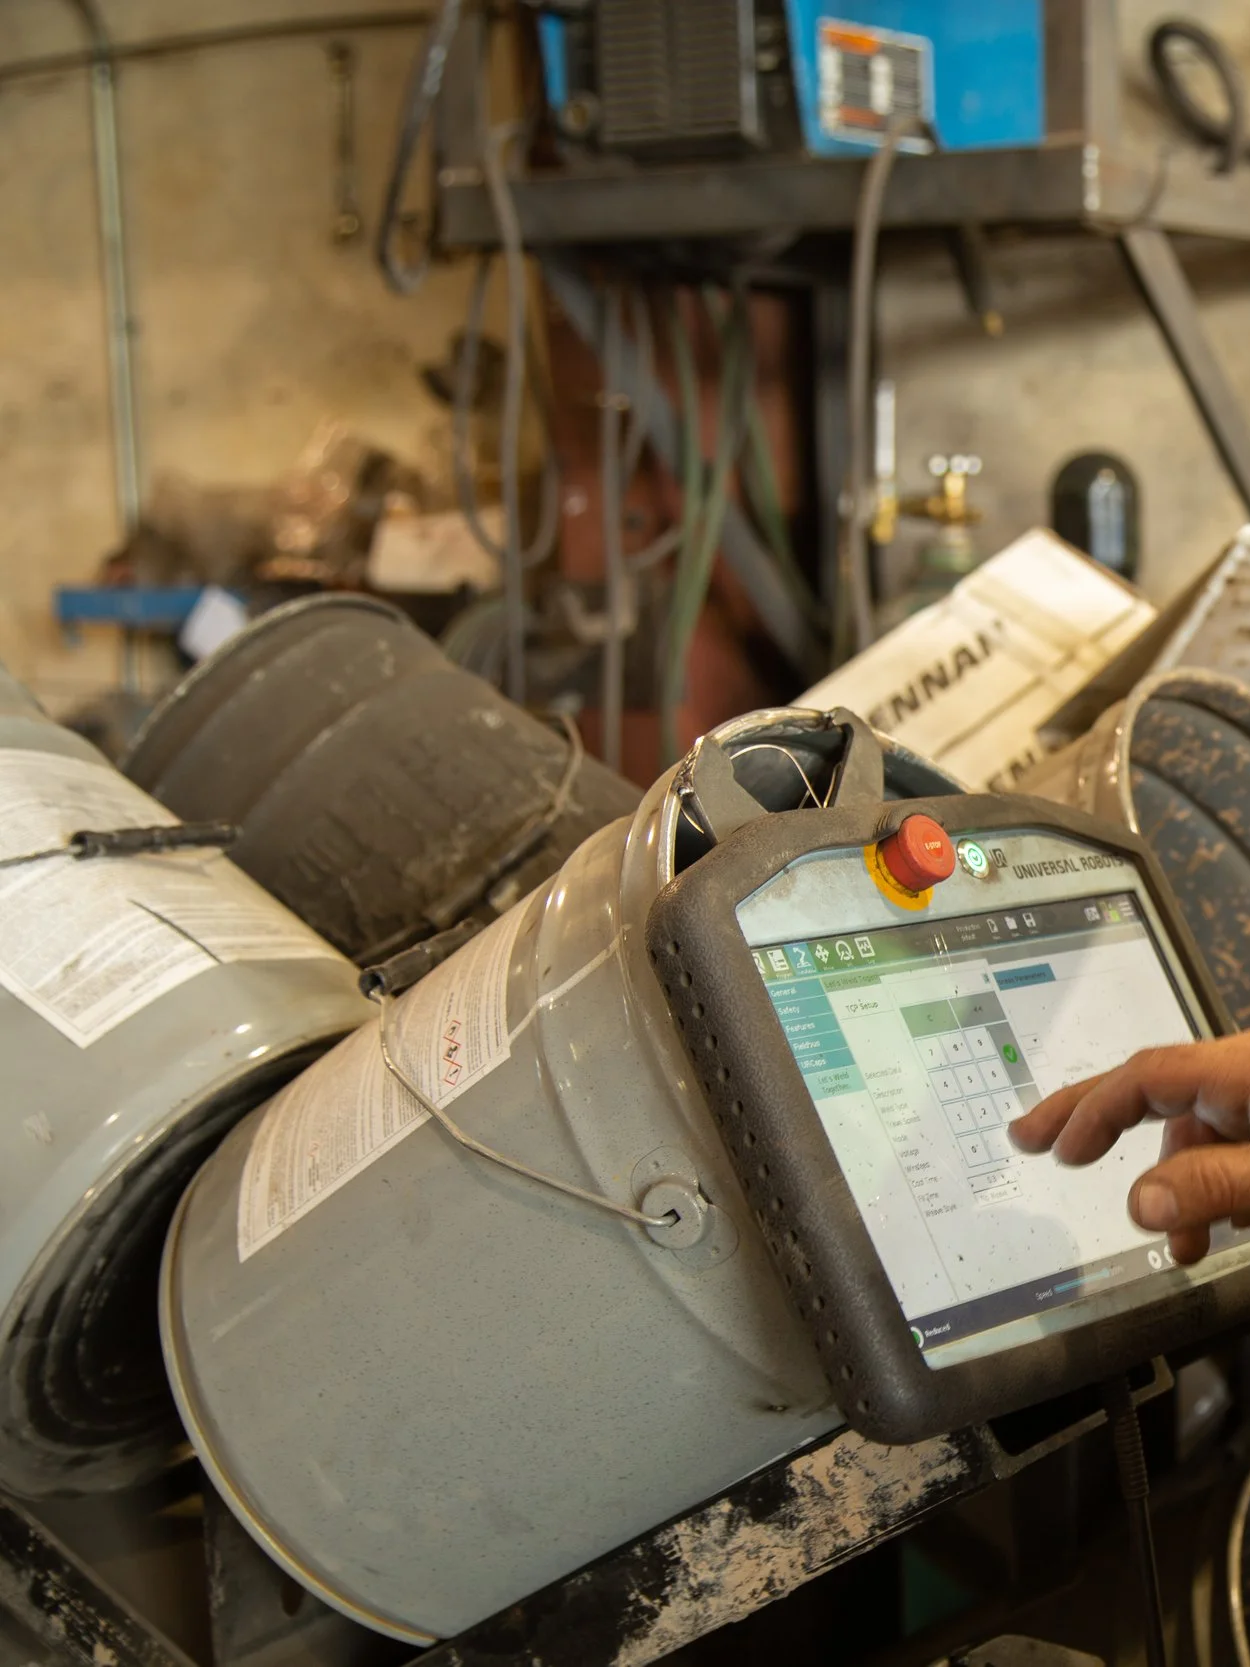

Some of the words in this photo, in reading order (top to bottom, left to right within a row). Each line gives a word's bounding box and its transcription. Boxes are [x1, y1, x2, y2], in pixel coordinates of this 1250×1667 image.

[1012, 858, 1080, 879] UNIVERSAL
[1079, 854, 1125, 871] ROBOTS
[770, 987, 797, 998] General
[778, 1006, 800, 1015] Safety
[845, 1003, 858, 1013] TCP
[859, 1001, 878, 1010] Setup
[785, 1022, 815, 1033] Features
